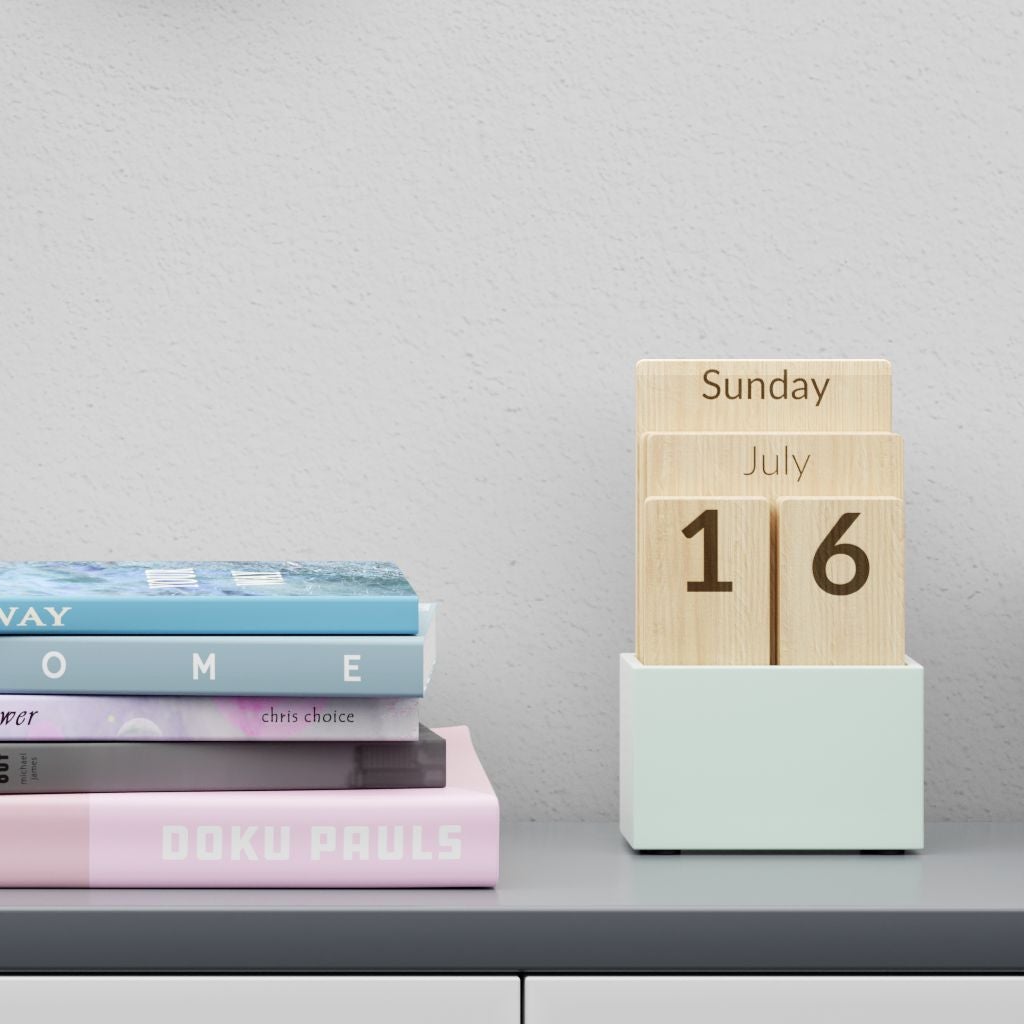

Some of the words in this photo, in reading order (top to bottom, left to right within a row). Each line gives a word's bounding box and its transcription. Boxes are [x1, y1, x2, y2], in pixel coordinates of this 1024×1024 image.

[701, 369, 831, 407] Sunday
[743, 445, 812, 483] July
[261, 707, 298, 724] chris
[304, 706, 355, 724] choice
[19, 753, 28, 785] michael
[31, 757, 39, 781] james
[162, 825, 290, 861] DOKU
[311, 824, 462, 861] PAULS
